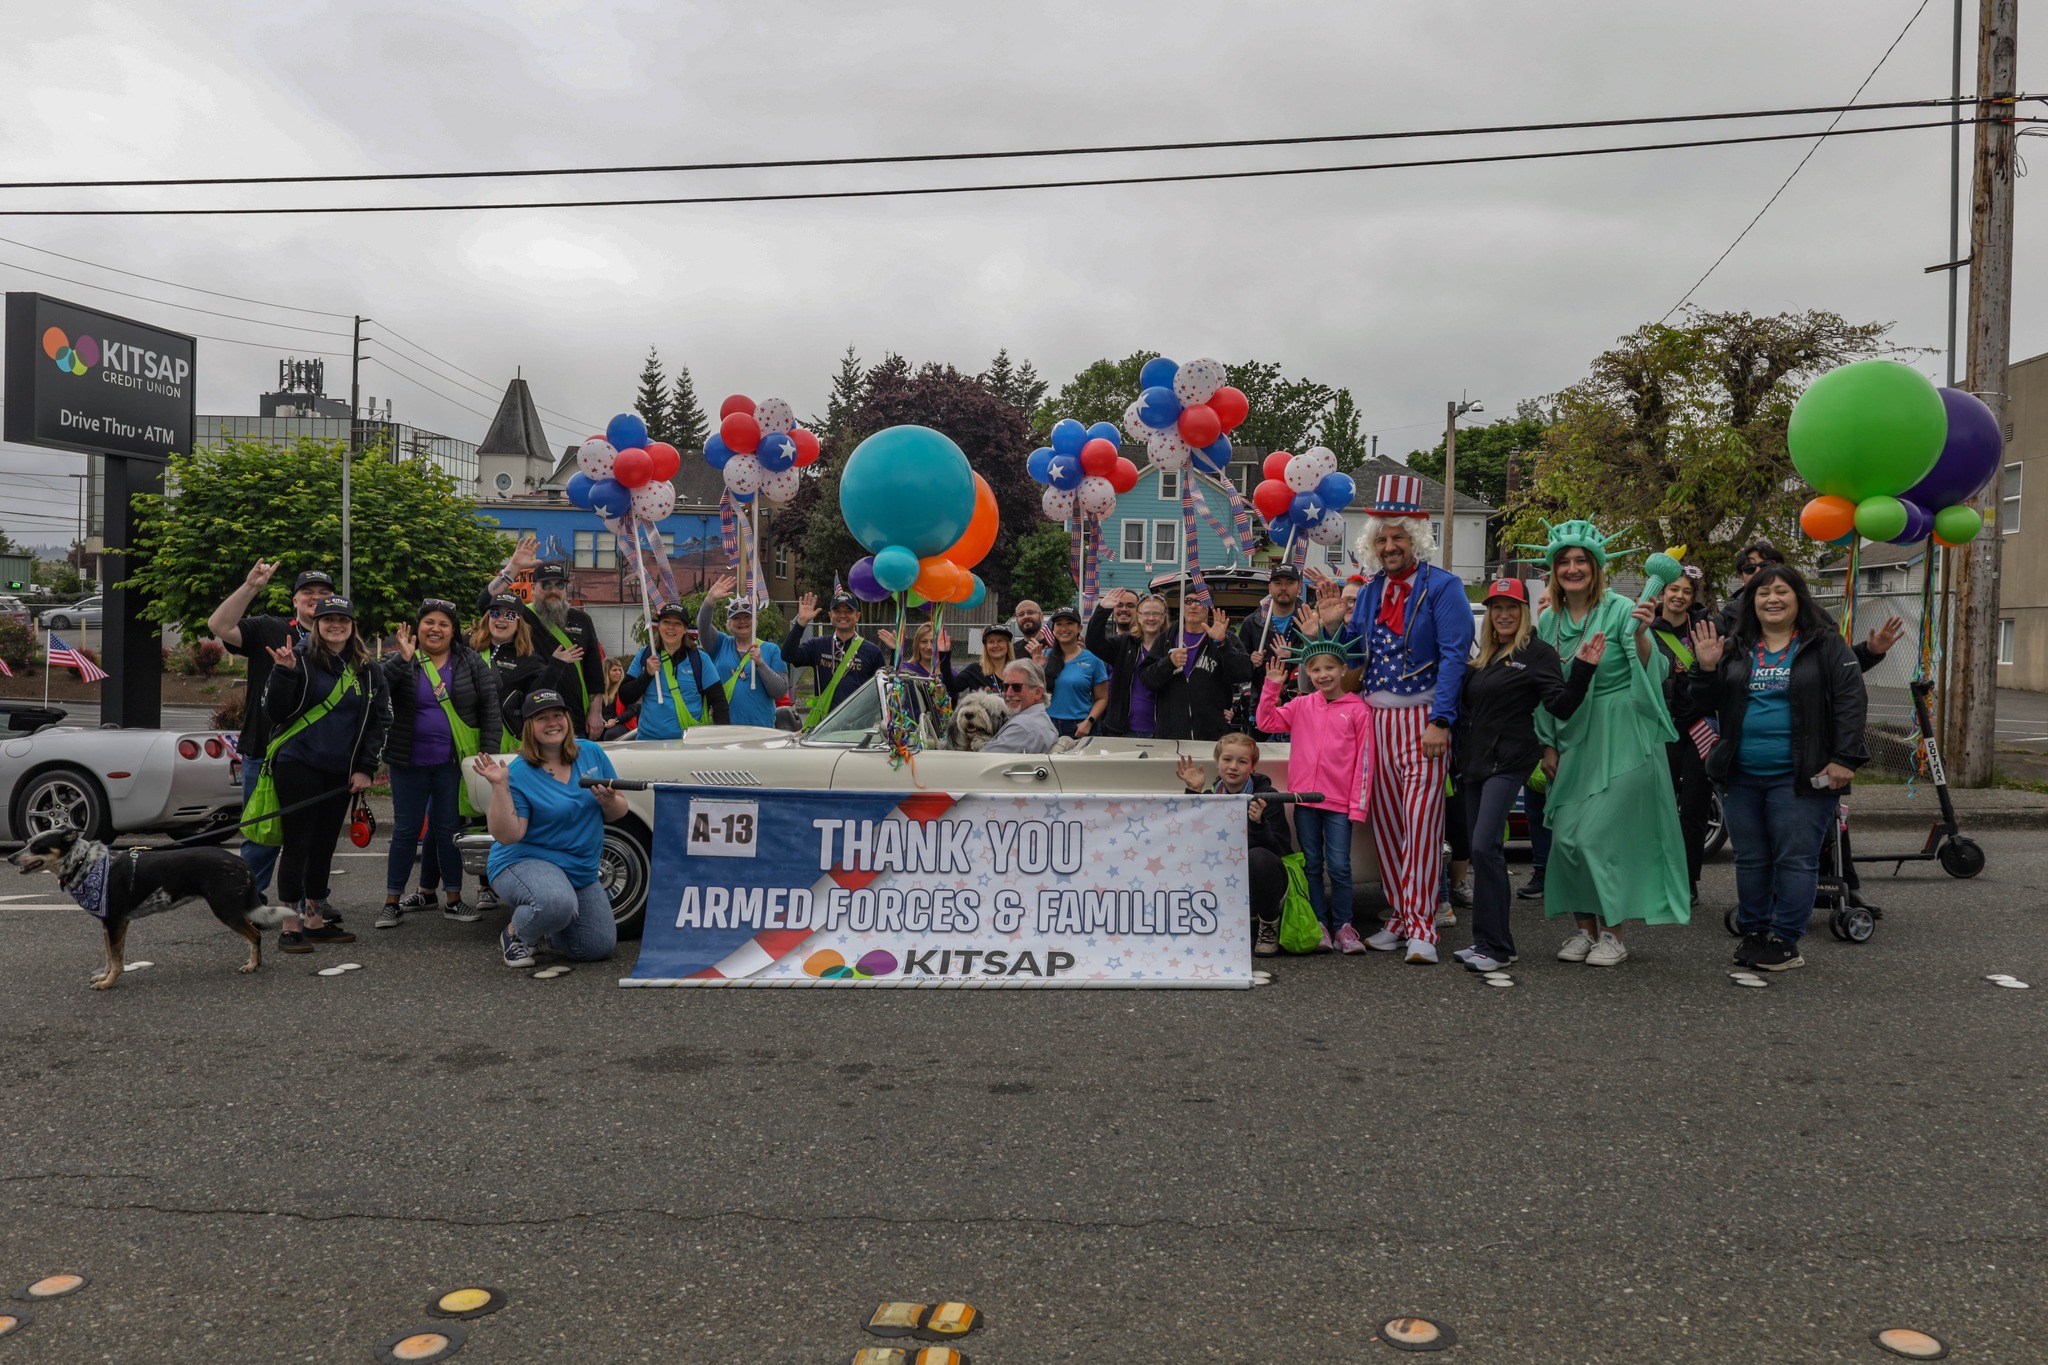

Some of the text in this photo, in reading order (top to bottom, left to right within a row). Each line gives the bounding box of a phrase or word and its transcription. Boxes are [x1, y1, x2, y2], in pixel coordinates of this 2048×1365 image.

[102, 339, 189, 385] KITSAP
[102, 370, 181, 399] CREDIT UNION
[60, 408, 174, 446] Drive Thru ATM
[1755, 667, 1791, 677] KITSA
[1928, 740, 1943, 782] GOTRAX
[691, 813, 755, 845] A-13
[812, 818, 1083, 875] THANK YOU
[675, 885, 1220, 936] ARMED FORCES & FAMILIES
[903, 949, 1076, 977] KITSAP
